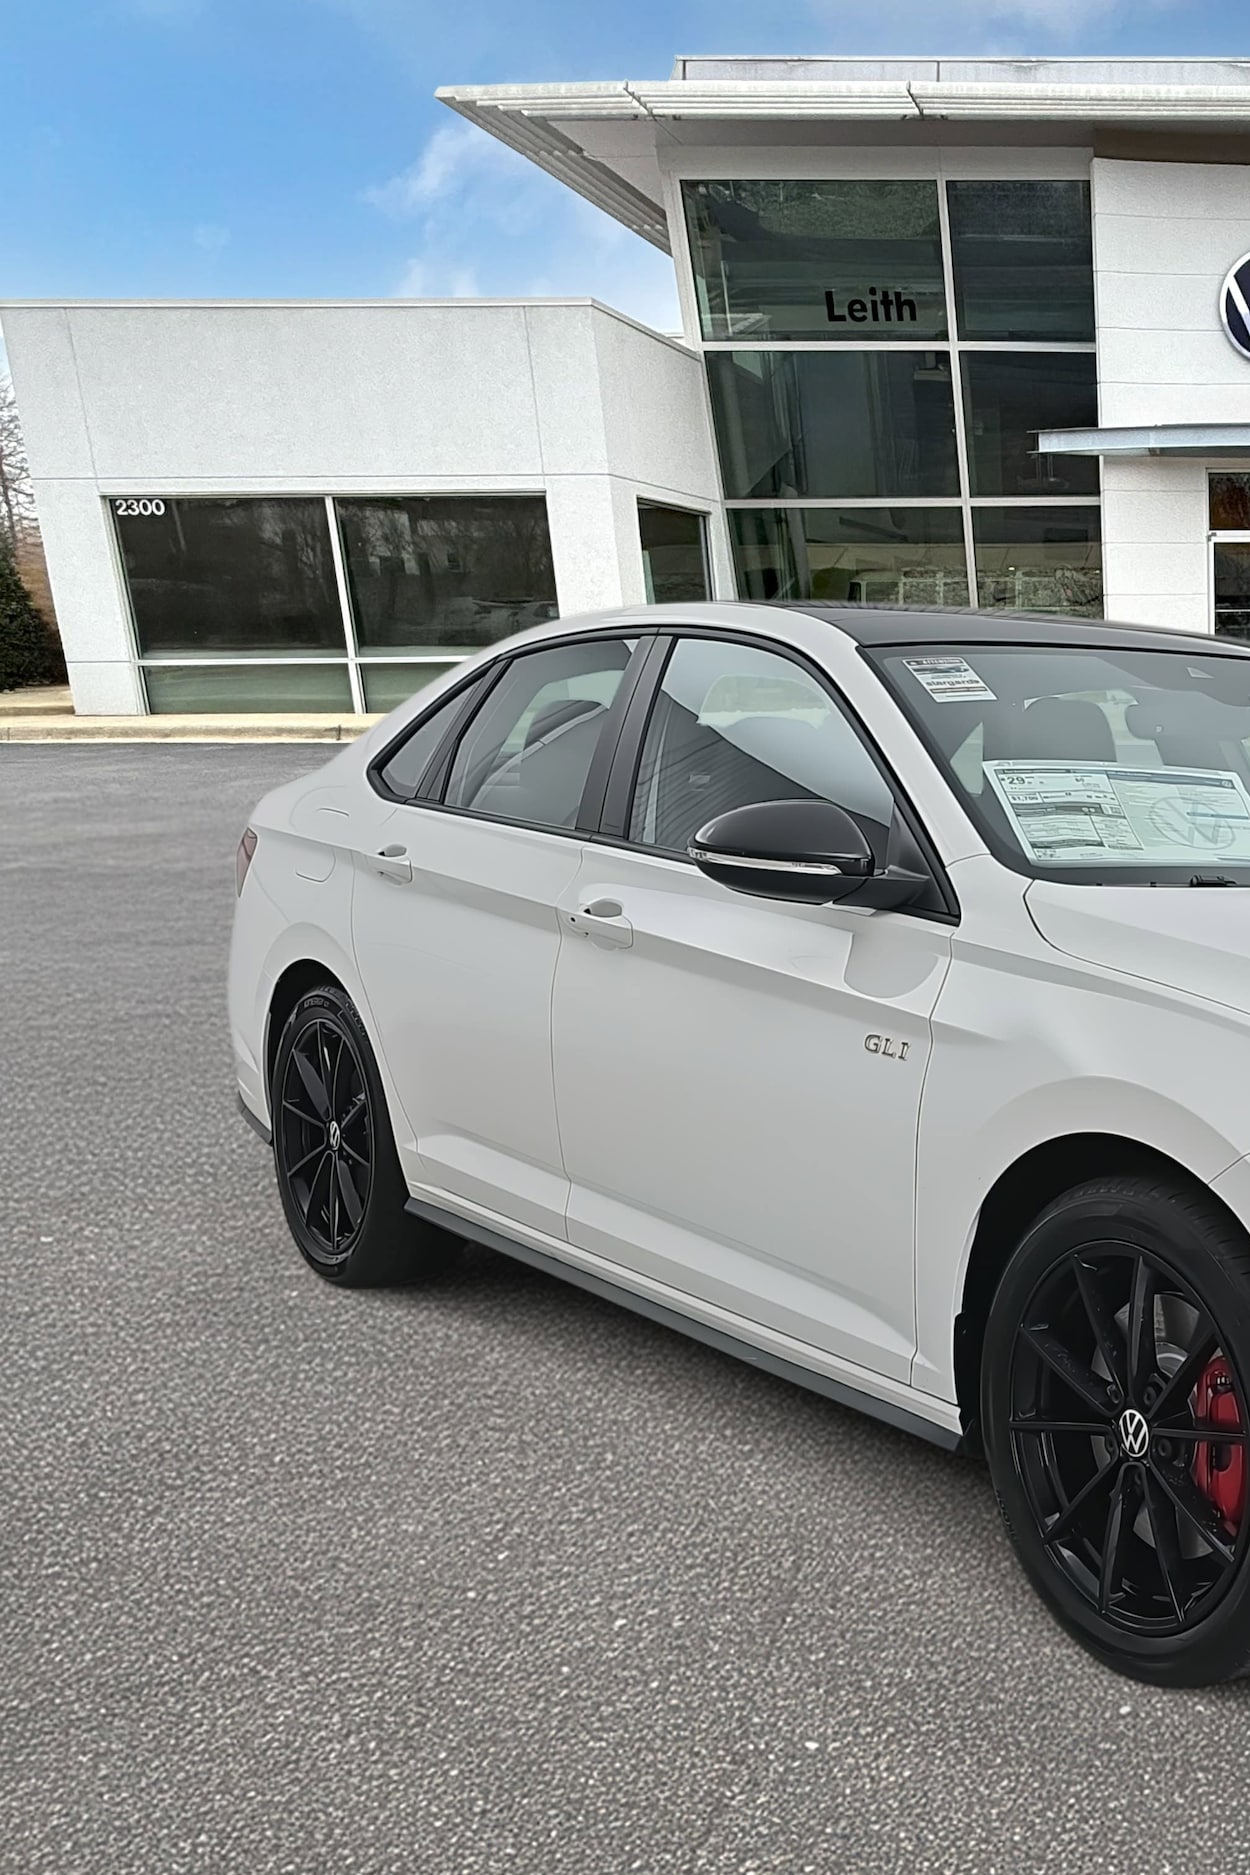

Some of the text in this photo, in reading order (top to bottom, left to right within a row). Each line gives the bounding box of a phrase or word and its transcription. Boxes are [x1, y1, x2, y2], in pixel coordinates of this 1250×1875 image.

[825, 287, 917, 322] Leith
[115, 499, 166, 516] 2300
[864, 1034, 909, 1061] GLI
[1120, 1410, 1148, 1456] VW
